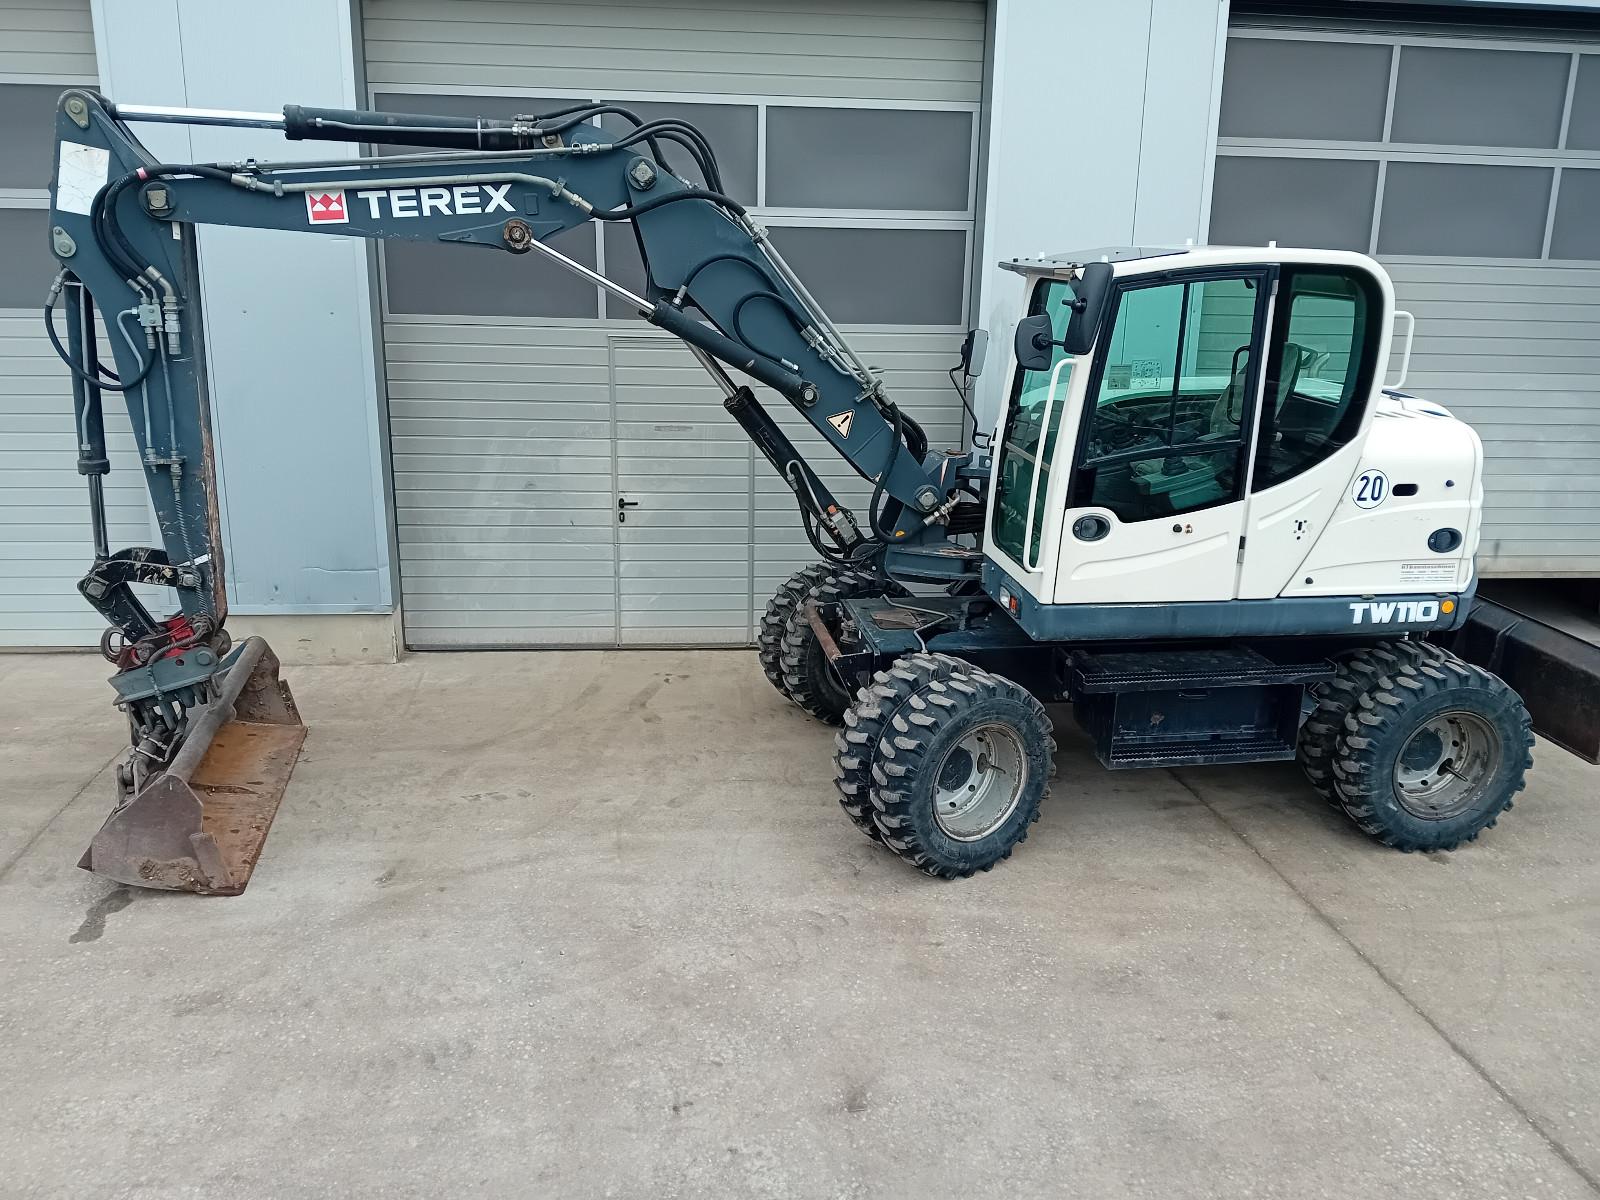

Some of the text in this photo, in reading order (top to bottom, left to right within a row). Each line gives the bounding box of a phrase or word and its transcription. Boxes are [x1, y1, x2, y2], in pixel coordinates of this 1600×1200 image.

[357, 183, 517, 219] TEREX
[1356, 475, 1384, 502] 20
[1349, 600, 1440, 624] TW110
